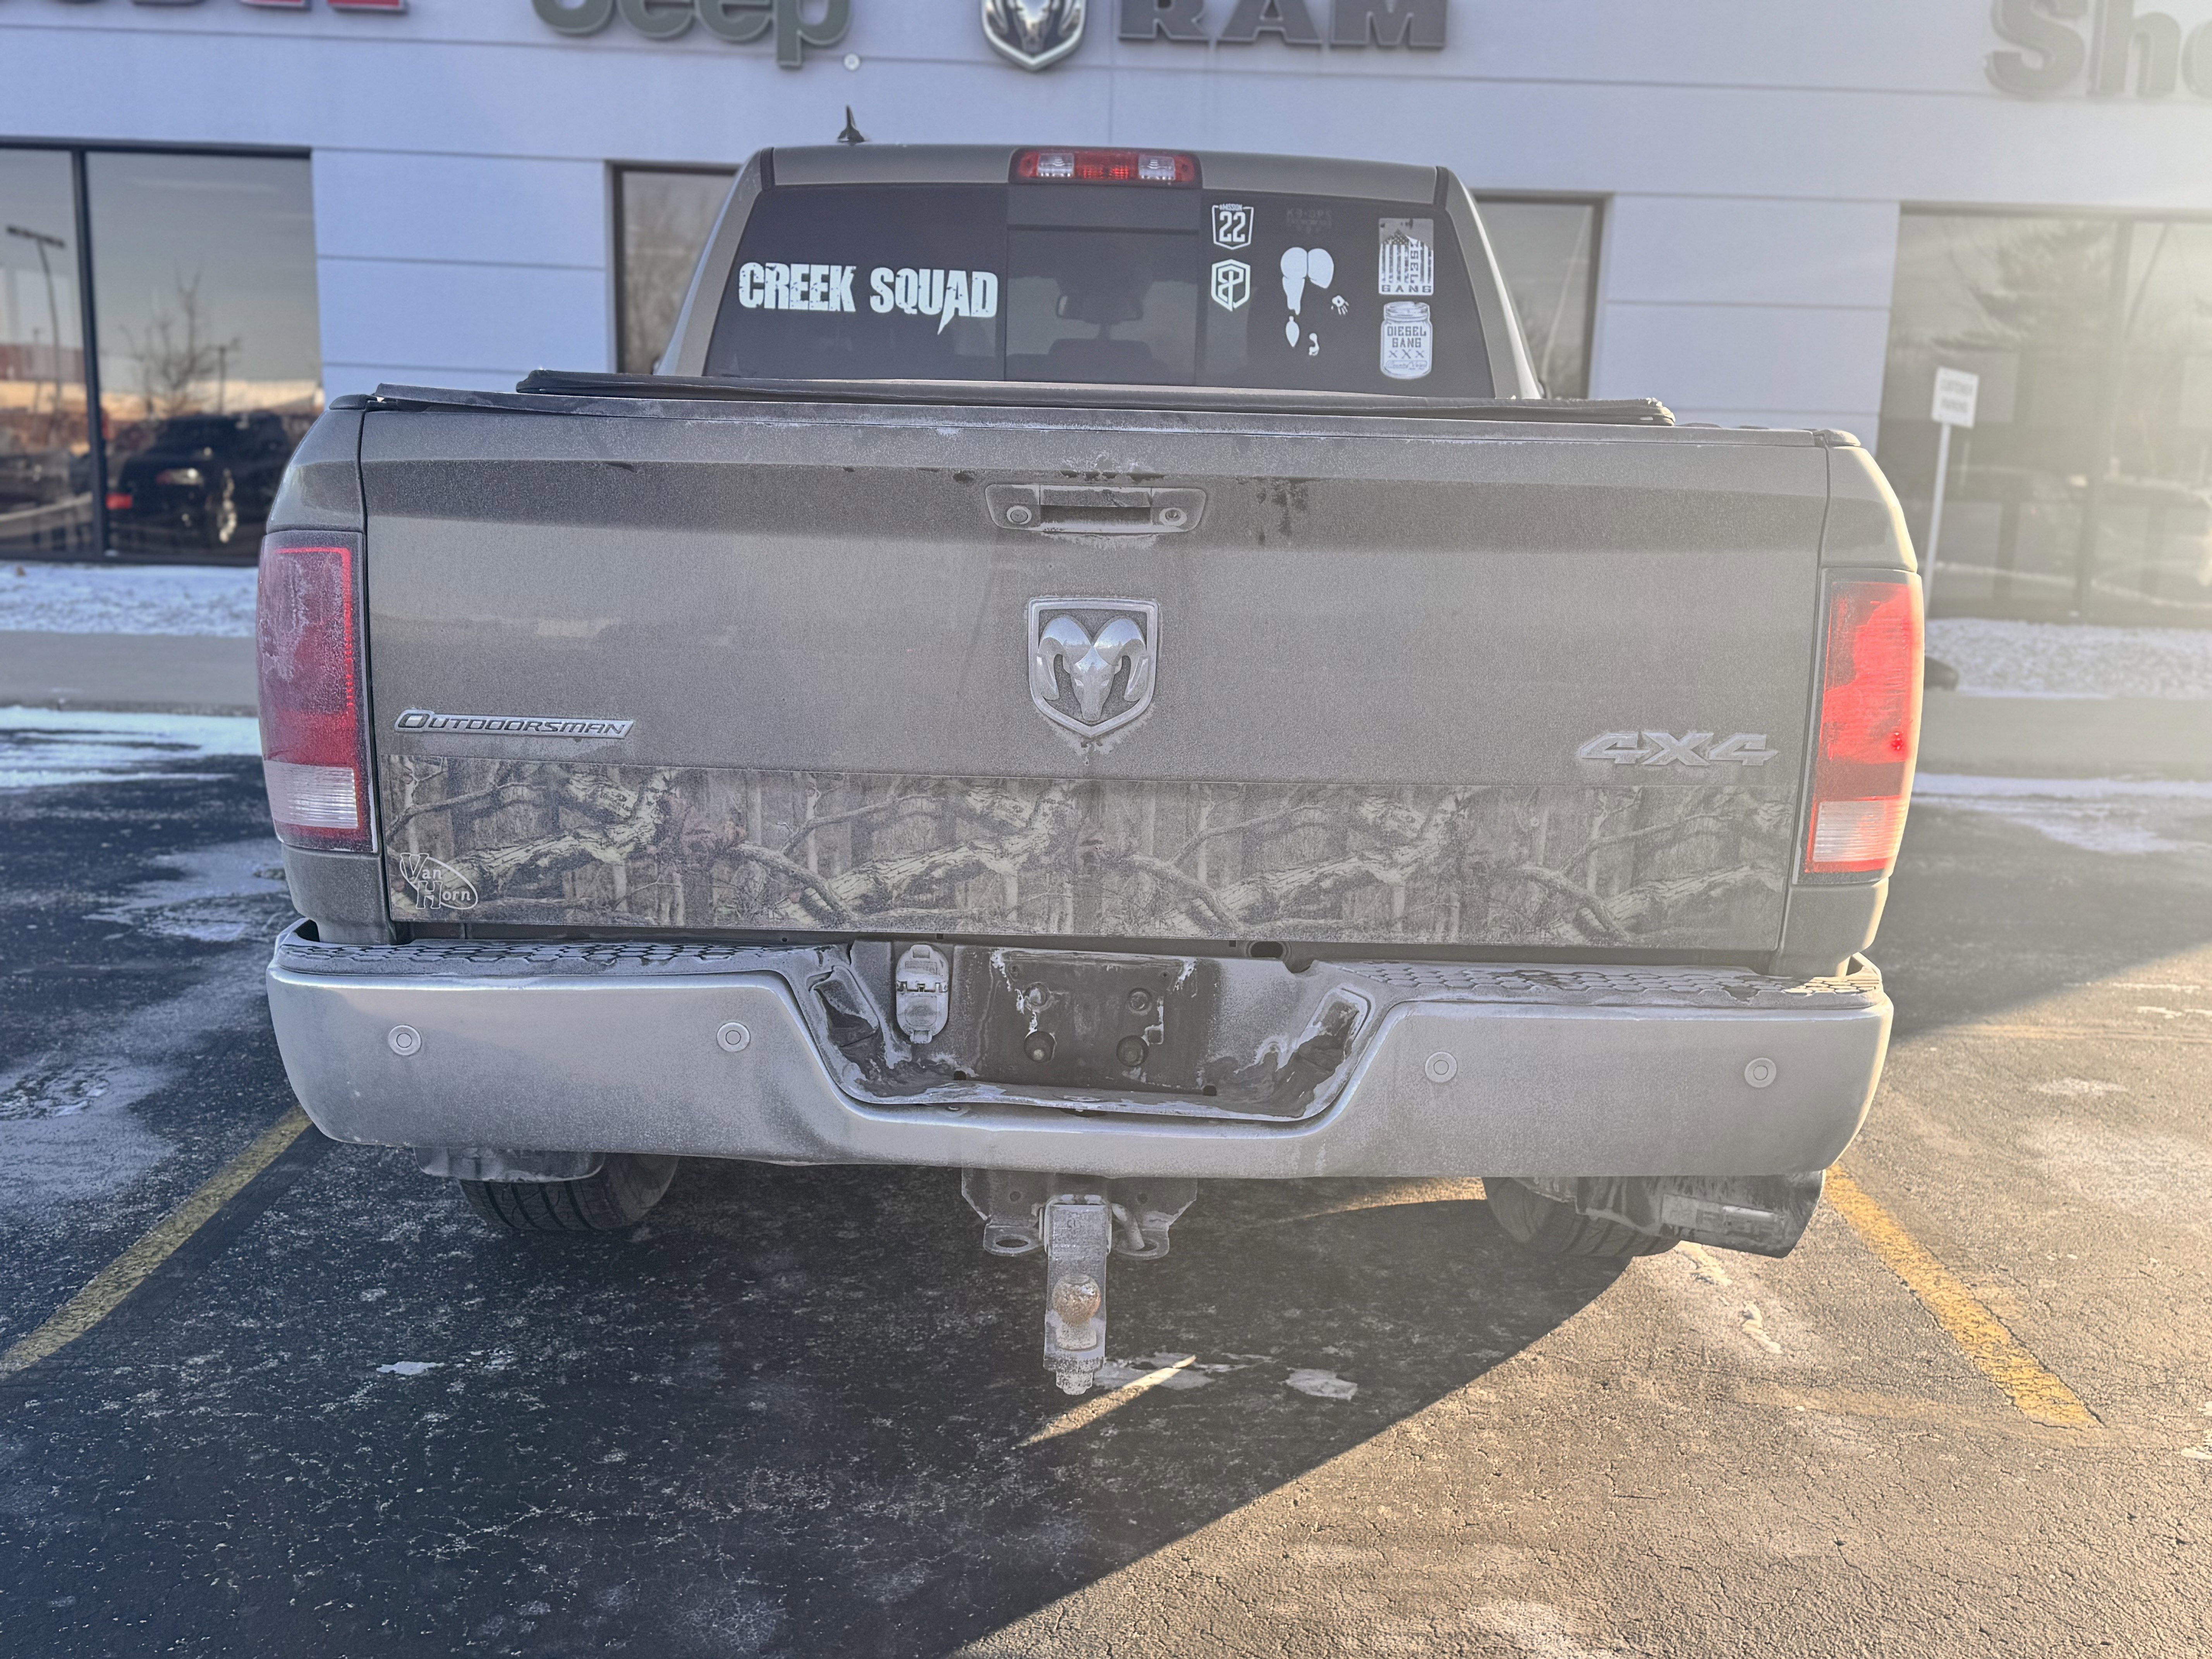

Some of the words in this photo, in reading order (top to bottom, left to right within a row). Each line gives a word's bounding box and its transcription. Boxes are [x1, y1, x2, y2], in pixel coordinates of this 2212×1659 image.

[1219, 211, 1246, 242] 22
[738, 262, 857, 312] CREEK
[869, 267, 998, 335] SQUAD
[1381, 284, 1432, 293] GANG
[1387, 326, 1427, 337] DIESEL
[1392, 337, 1422, 348] GANG
[1579, 732, 1778, 766] 4X4
[400, 852, 442, 884] Van
[416, 880, 471, 909] Horn
